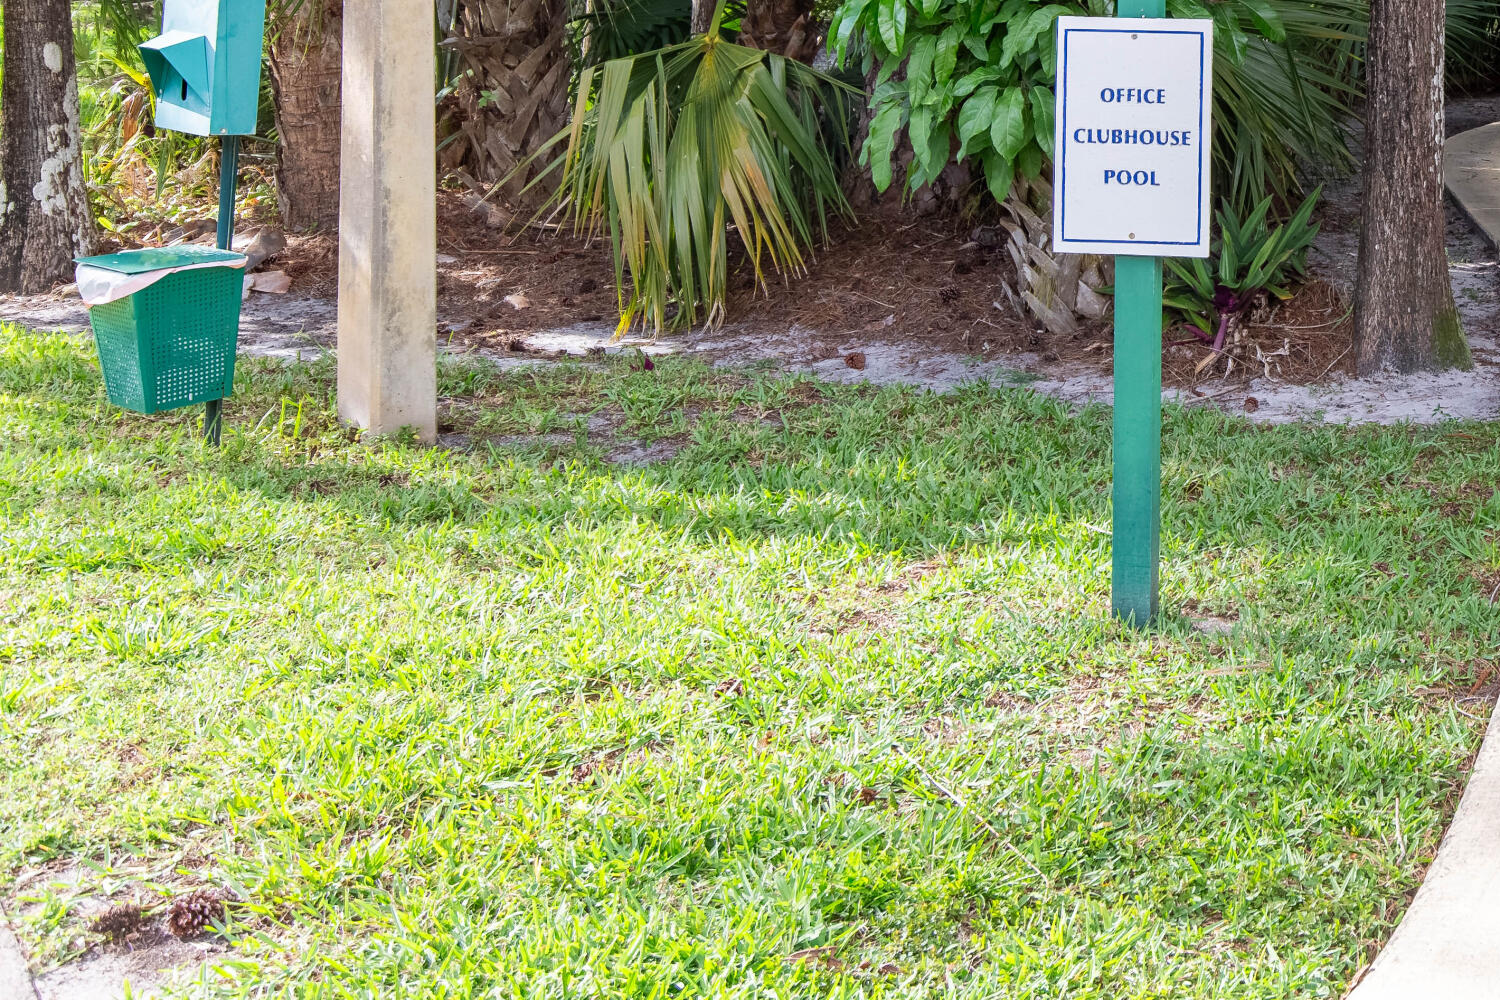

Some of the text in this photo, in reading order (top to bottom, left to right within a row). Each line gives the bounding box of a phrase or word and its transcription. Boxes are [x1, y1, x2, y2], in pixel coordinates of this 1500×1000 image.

[1100, 87, 1166, 104] OFFICE
[1073, 128, 1191, 146] CLUBHOUSE
[1103, 169, 1160, 186] POOL
